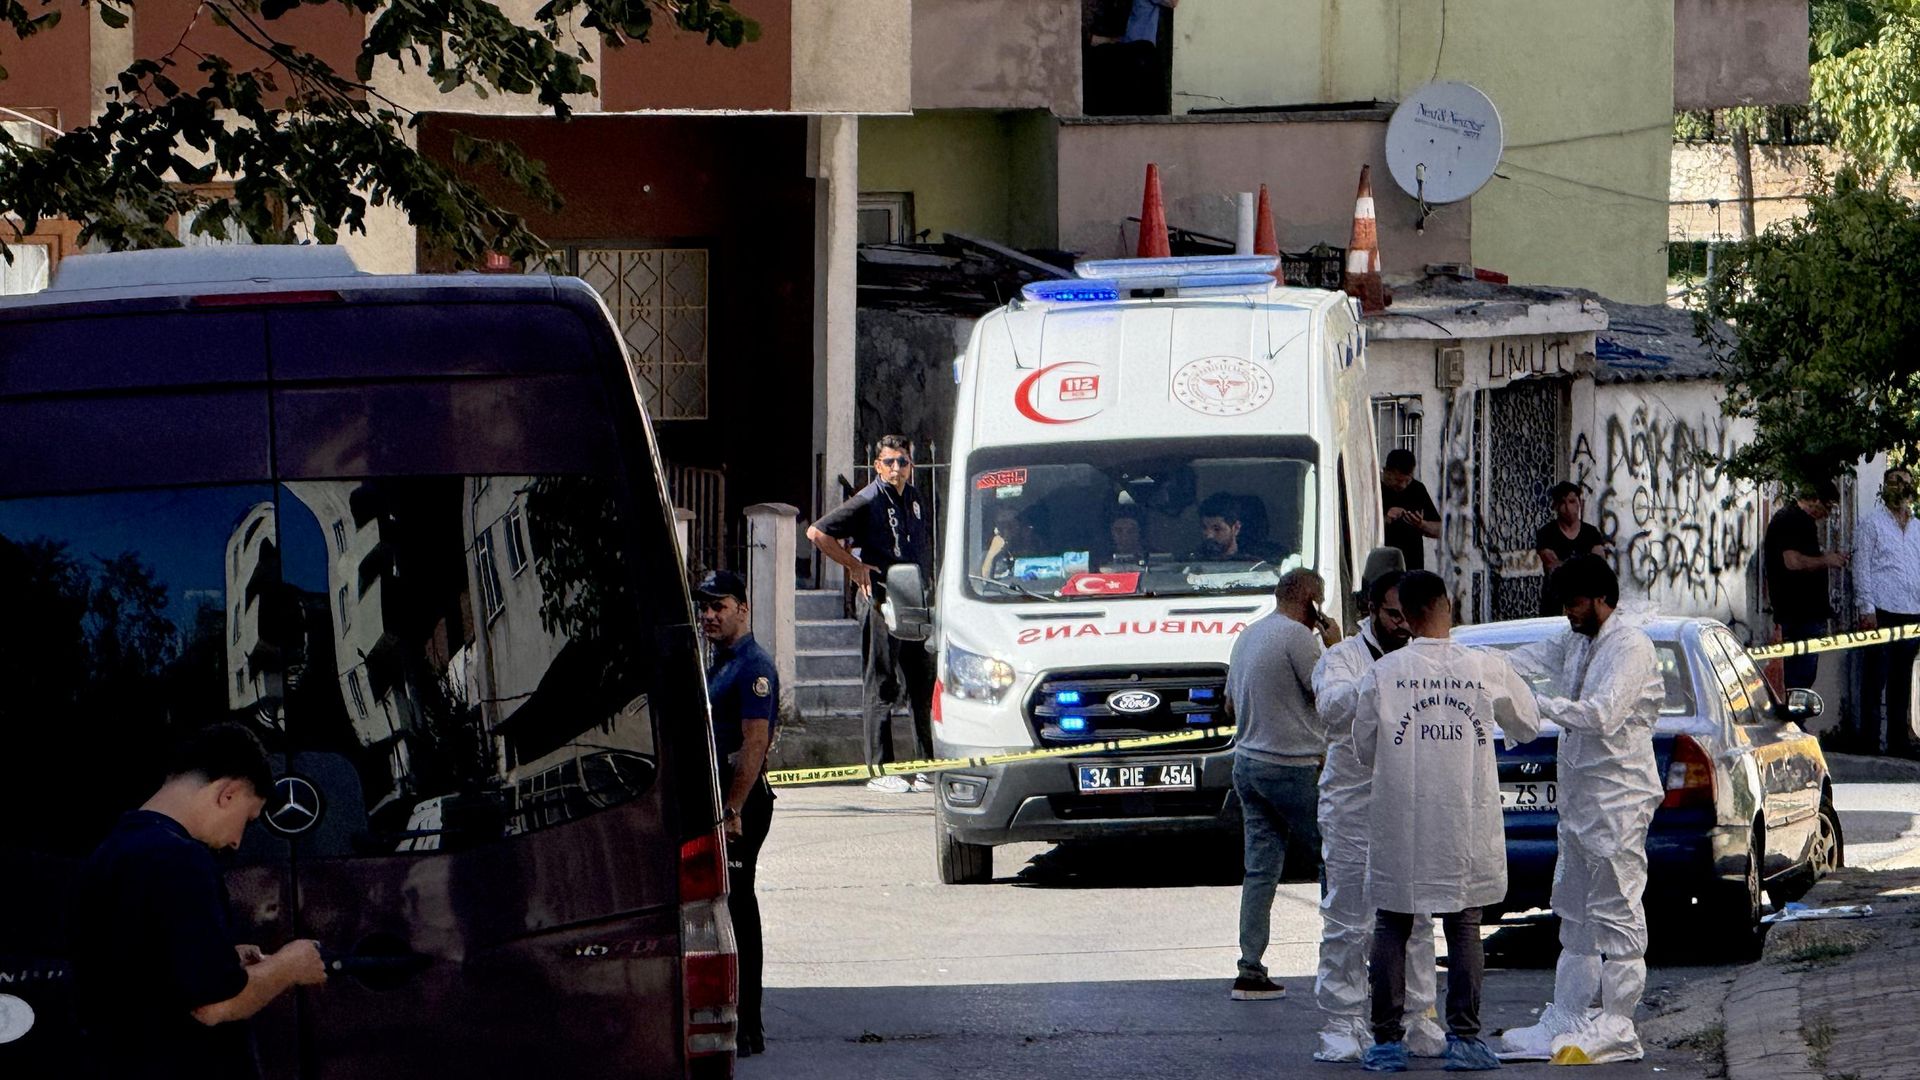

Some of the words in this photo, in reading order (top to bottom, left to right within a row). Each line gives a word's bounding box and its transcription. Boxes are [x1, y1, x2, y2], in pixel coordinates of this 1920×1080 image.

[1065, 379, 1094, 391] 112
[1119, 694, 1150, 709] Ford
[1394, 712, 1412, 746] OLAY
[1090, 768, 1111, 787] 34
[1120, 767, 1145, 786] PIE
[1160, 765, 1191, 785] 454
[1515, 784, 1538, 804] ZS
